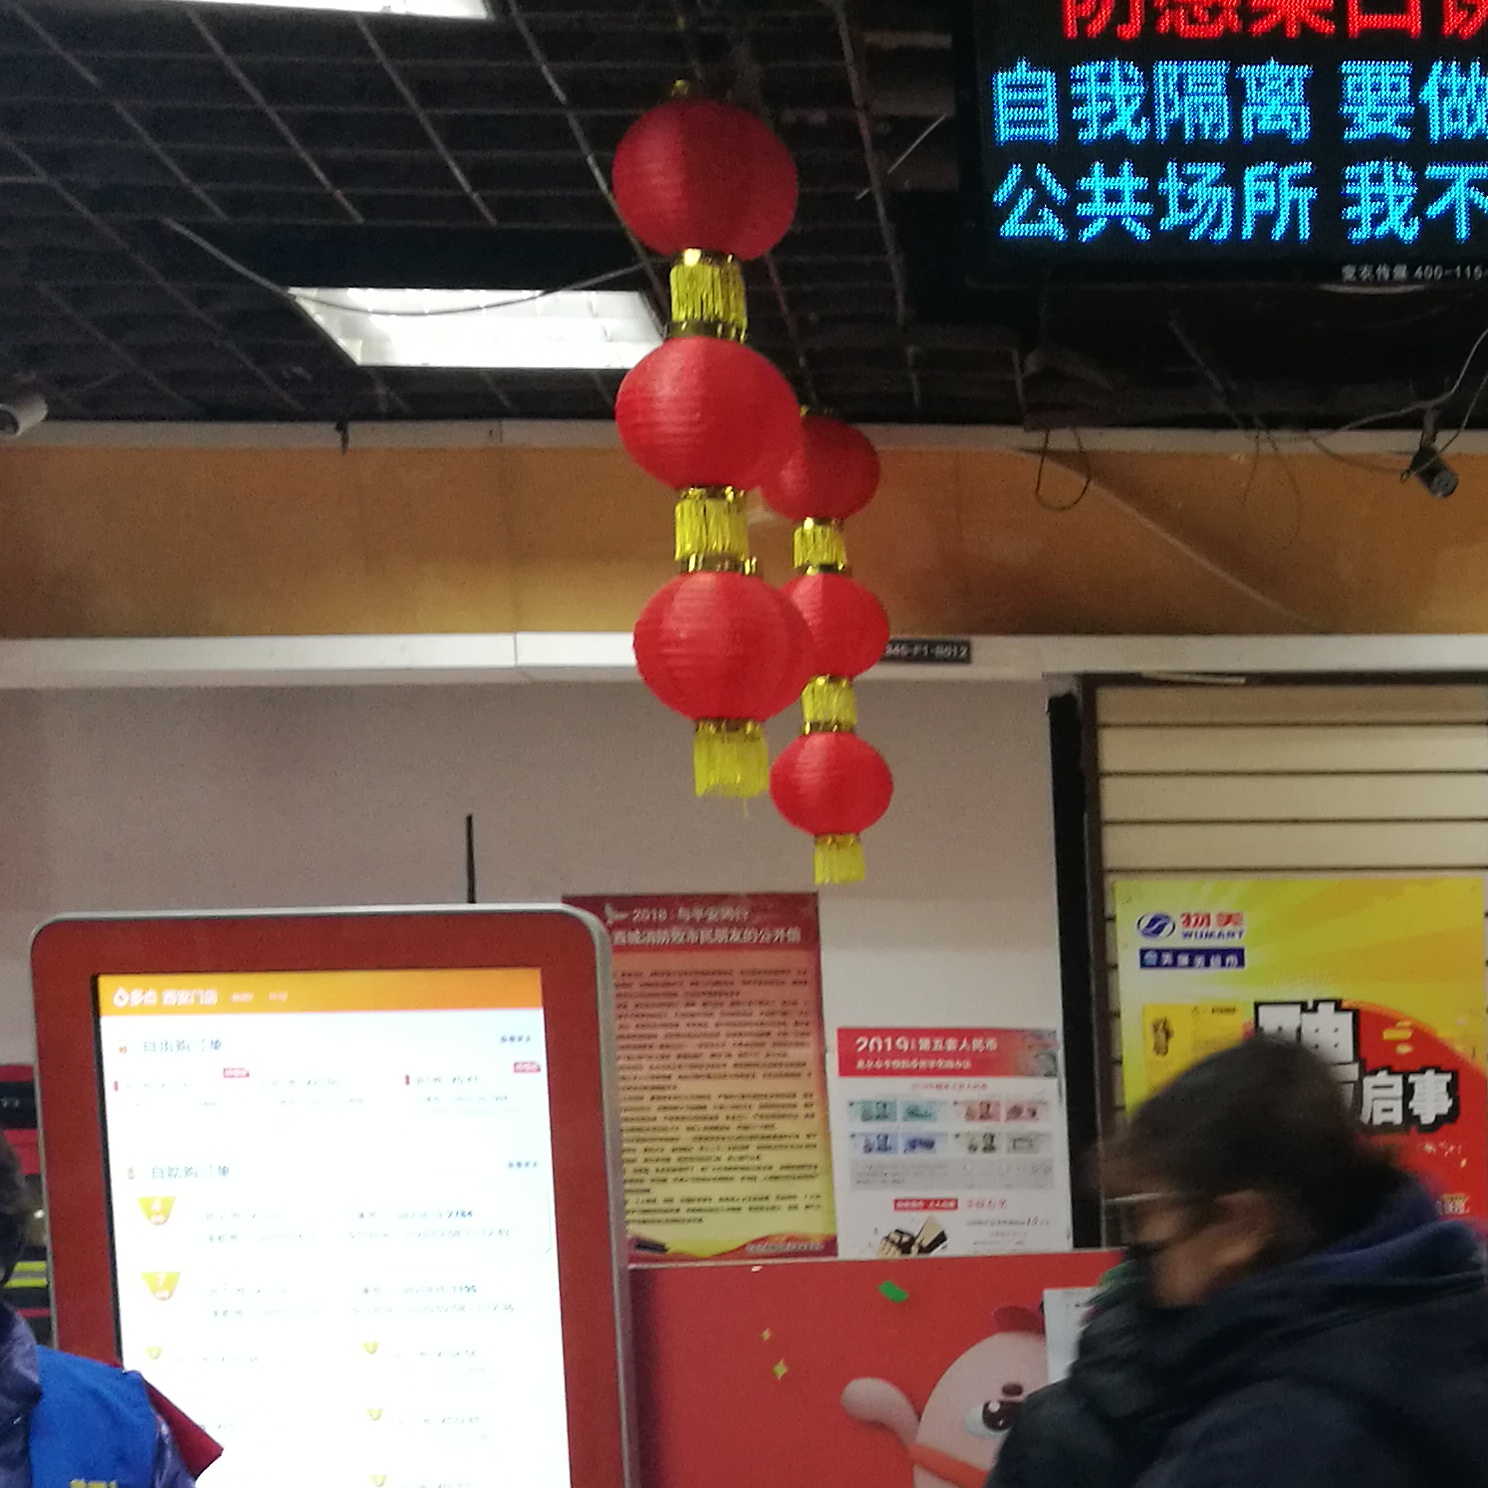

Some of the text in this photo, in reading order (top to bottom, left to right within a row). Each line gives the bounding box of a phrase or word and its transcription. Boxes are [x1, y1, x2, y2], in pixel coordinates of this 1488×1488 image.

[991, 56, 1313, 143] 自我隔离
[992, 160, 1317, 243] 公共场所
[1360, 1069, 1453, 1125] 启事
